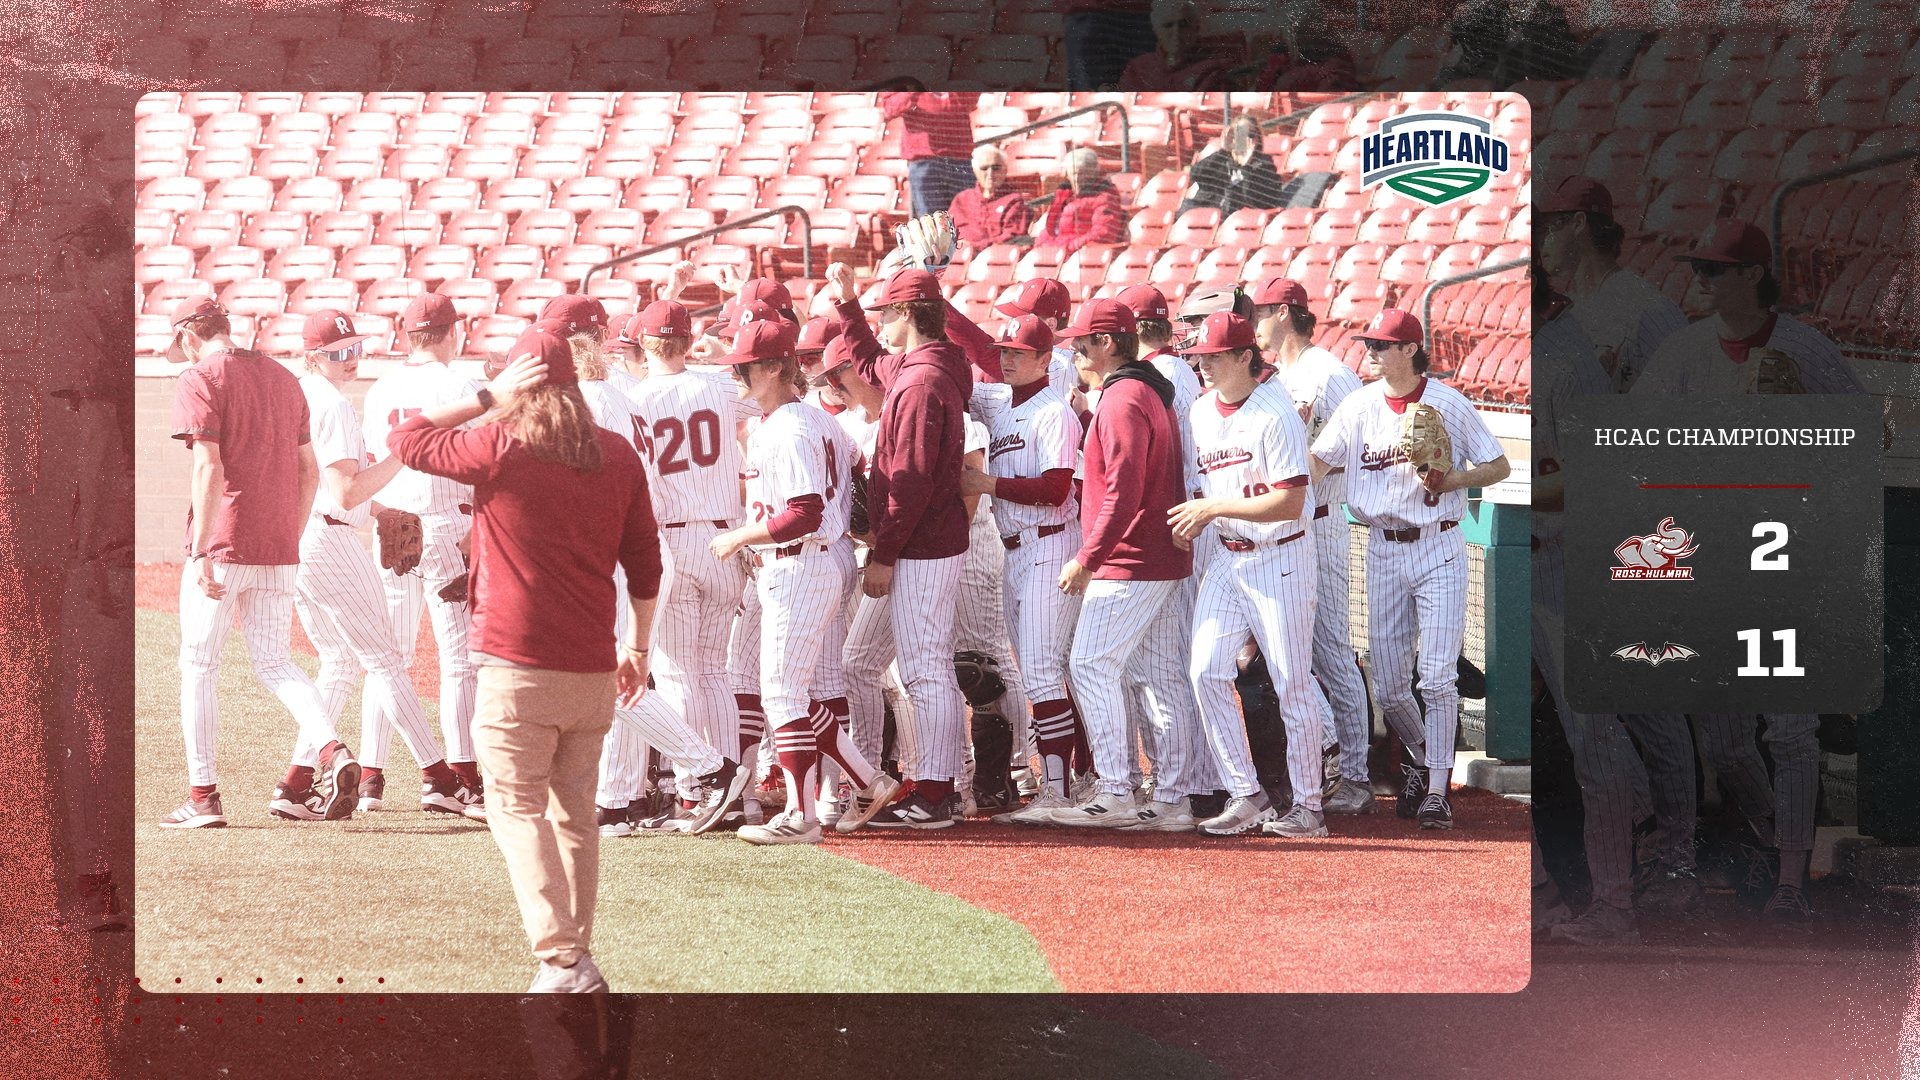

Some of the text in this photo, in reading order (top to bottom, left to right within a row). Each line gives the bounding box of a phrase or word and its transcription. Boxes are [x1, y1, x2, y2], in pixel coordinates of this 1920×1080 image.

[334, 316, 351, 335] R
[1007, 319, 1021, 338] R
[1370, 311, 1384, 330] R
[1198, 323, 1209, 344] R
[653, 408, 721, 477] 20
